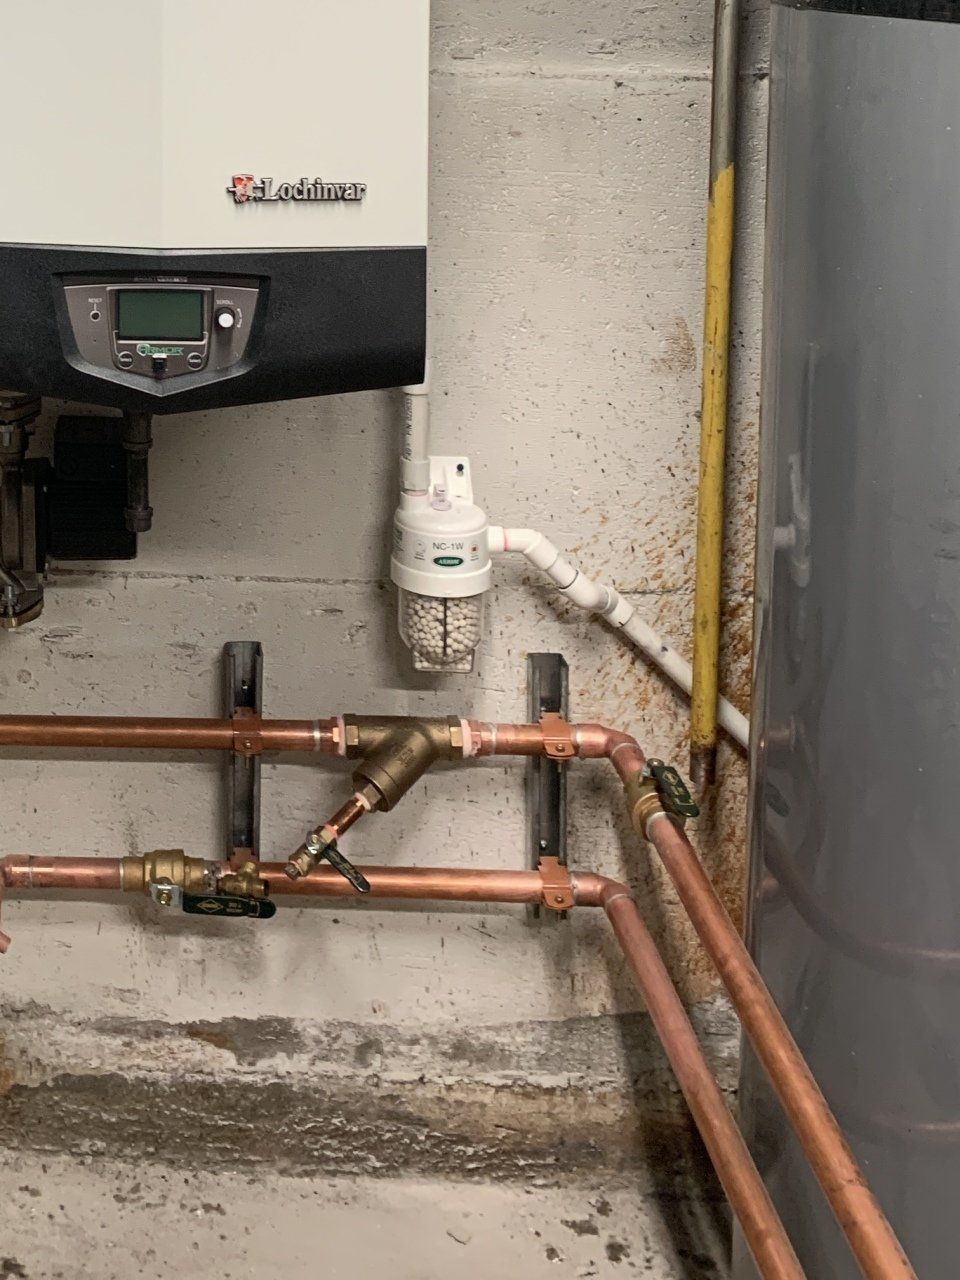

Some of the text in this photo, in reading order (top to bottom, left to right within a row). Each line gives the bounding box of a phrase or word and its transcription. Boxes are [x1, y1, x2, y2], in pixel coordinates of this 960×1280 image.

[261, 177, 367, 202] Lochinvar
[136, 343, 185, 357] ARMOR
[432, 542, 465, 551] NC-1W
